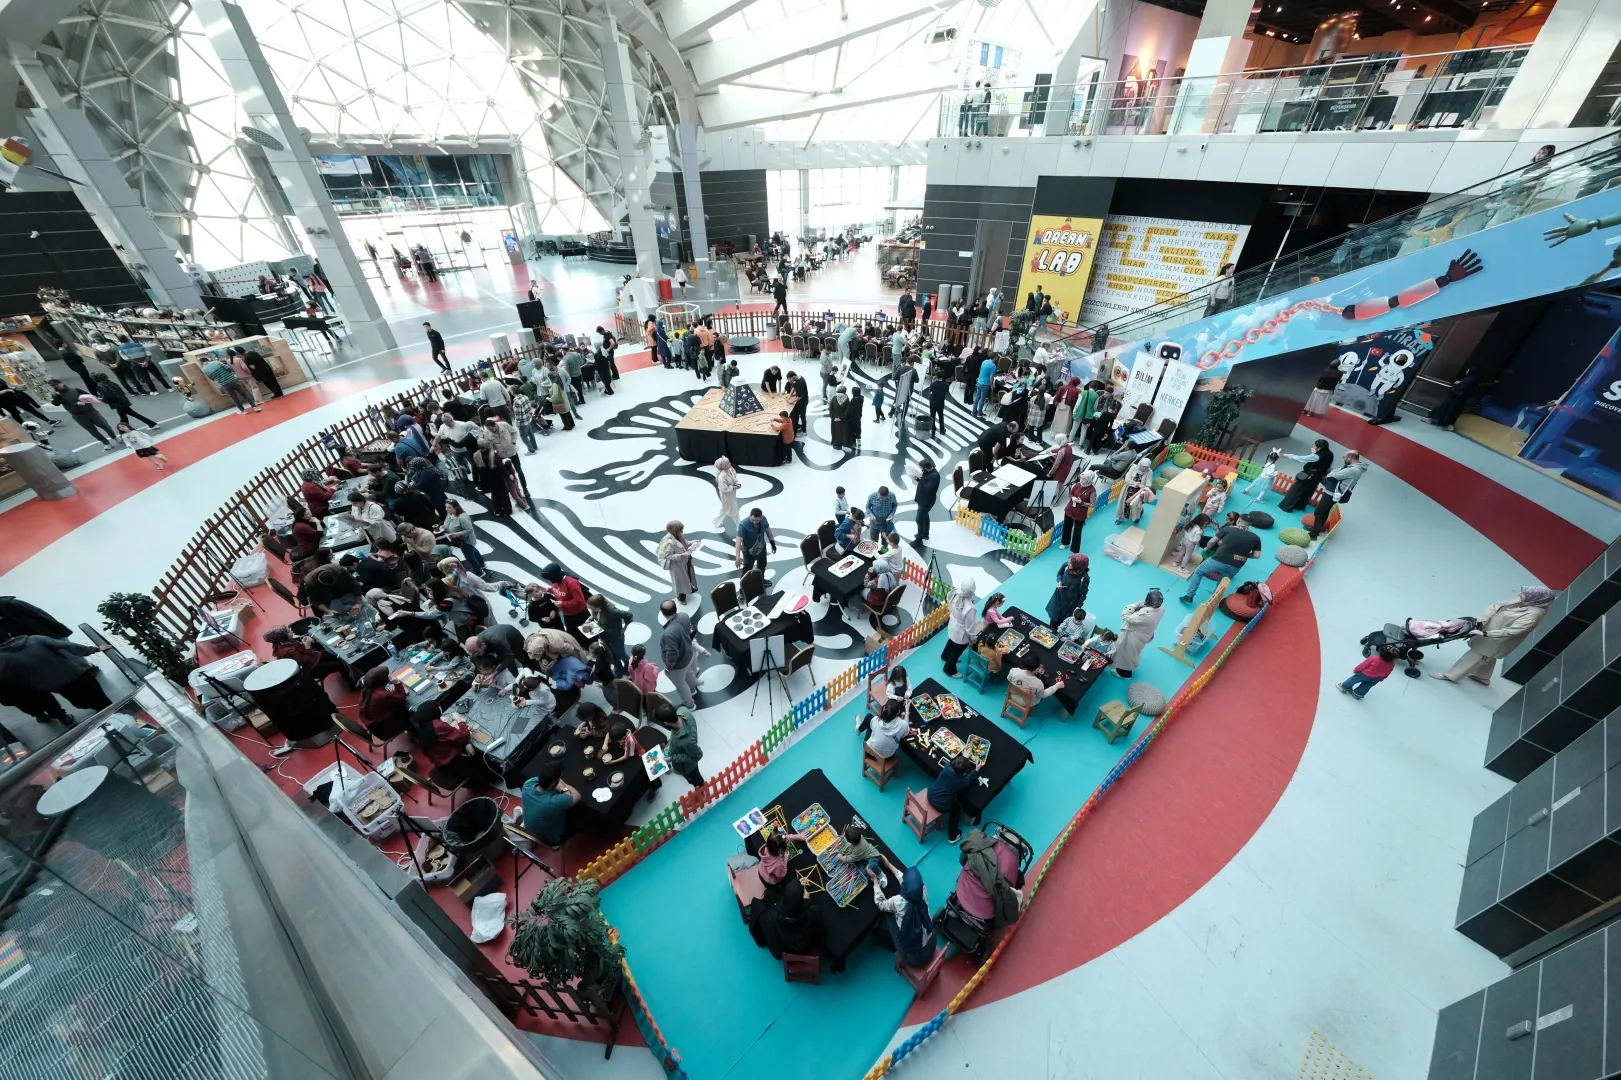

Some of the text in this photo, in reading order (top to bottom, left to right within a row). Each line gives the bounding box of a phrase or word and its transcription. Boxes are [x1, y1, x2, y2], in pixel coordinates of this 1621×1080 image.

[1041, 229, 1088, 247] DREAM
[1038, 249, 1083, 274] LAB
[1135, 369, 1153, 385] BİLİM
[1160, 392, 1184, 408] HERKES
